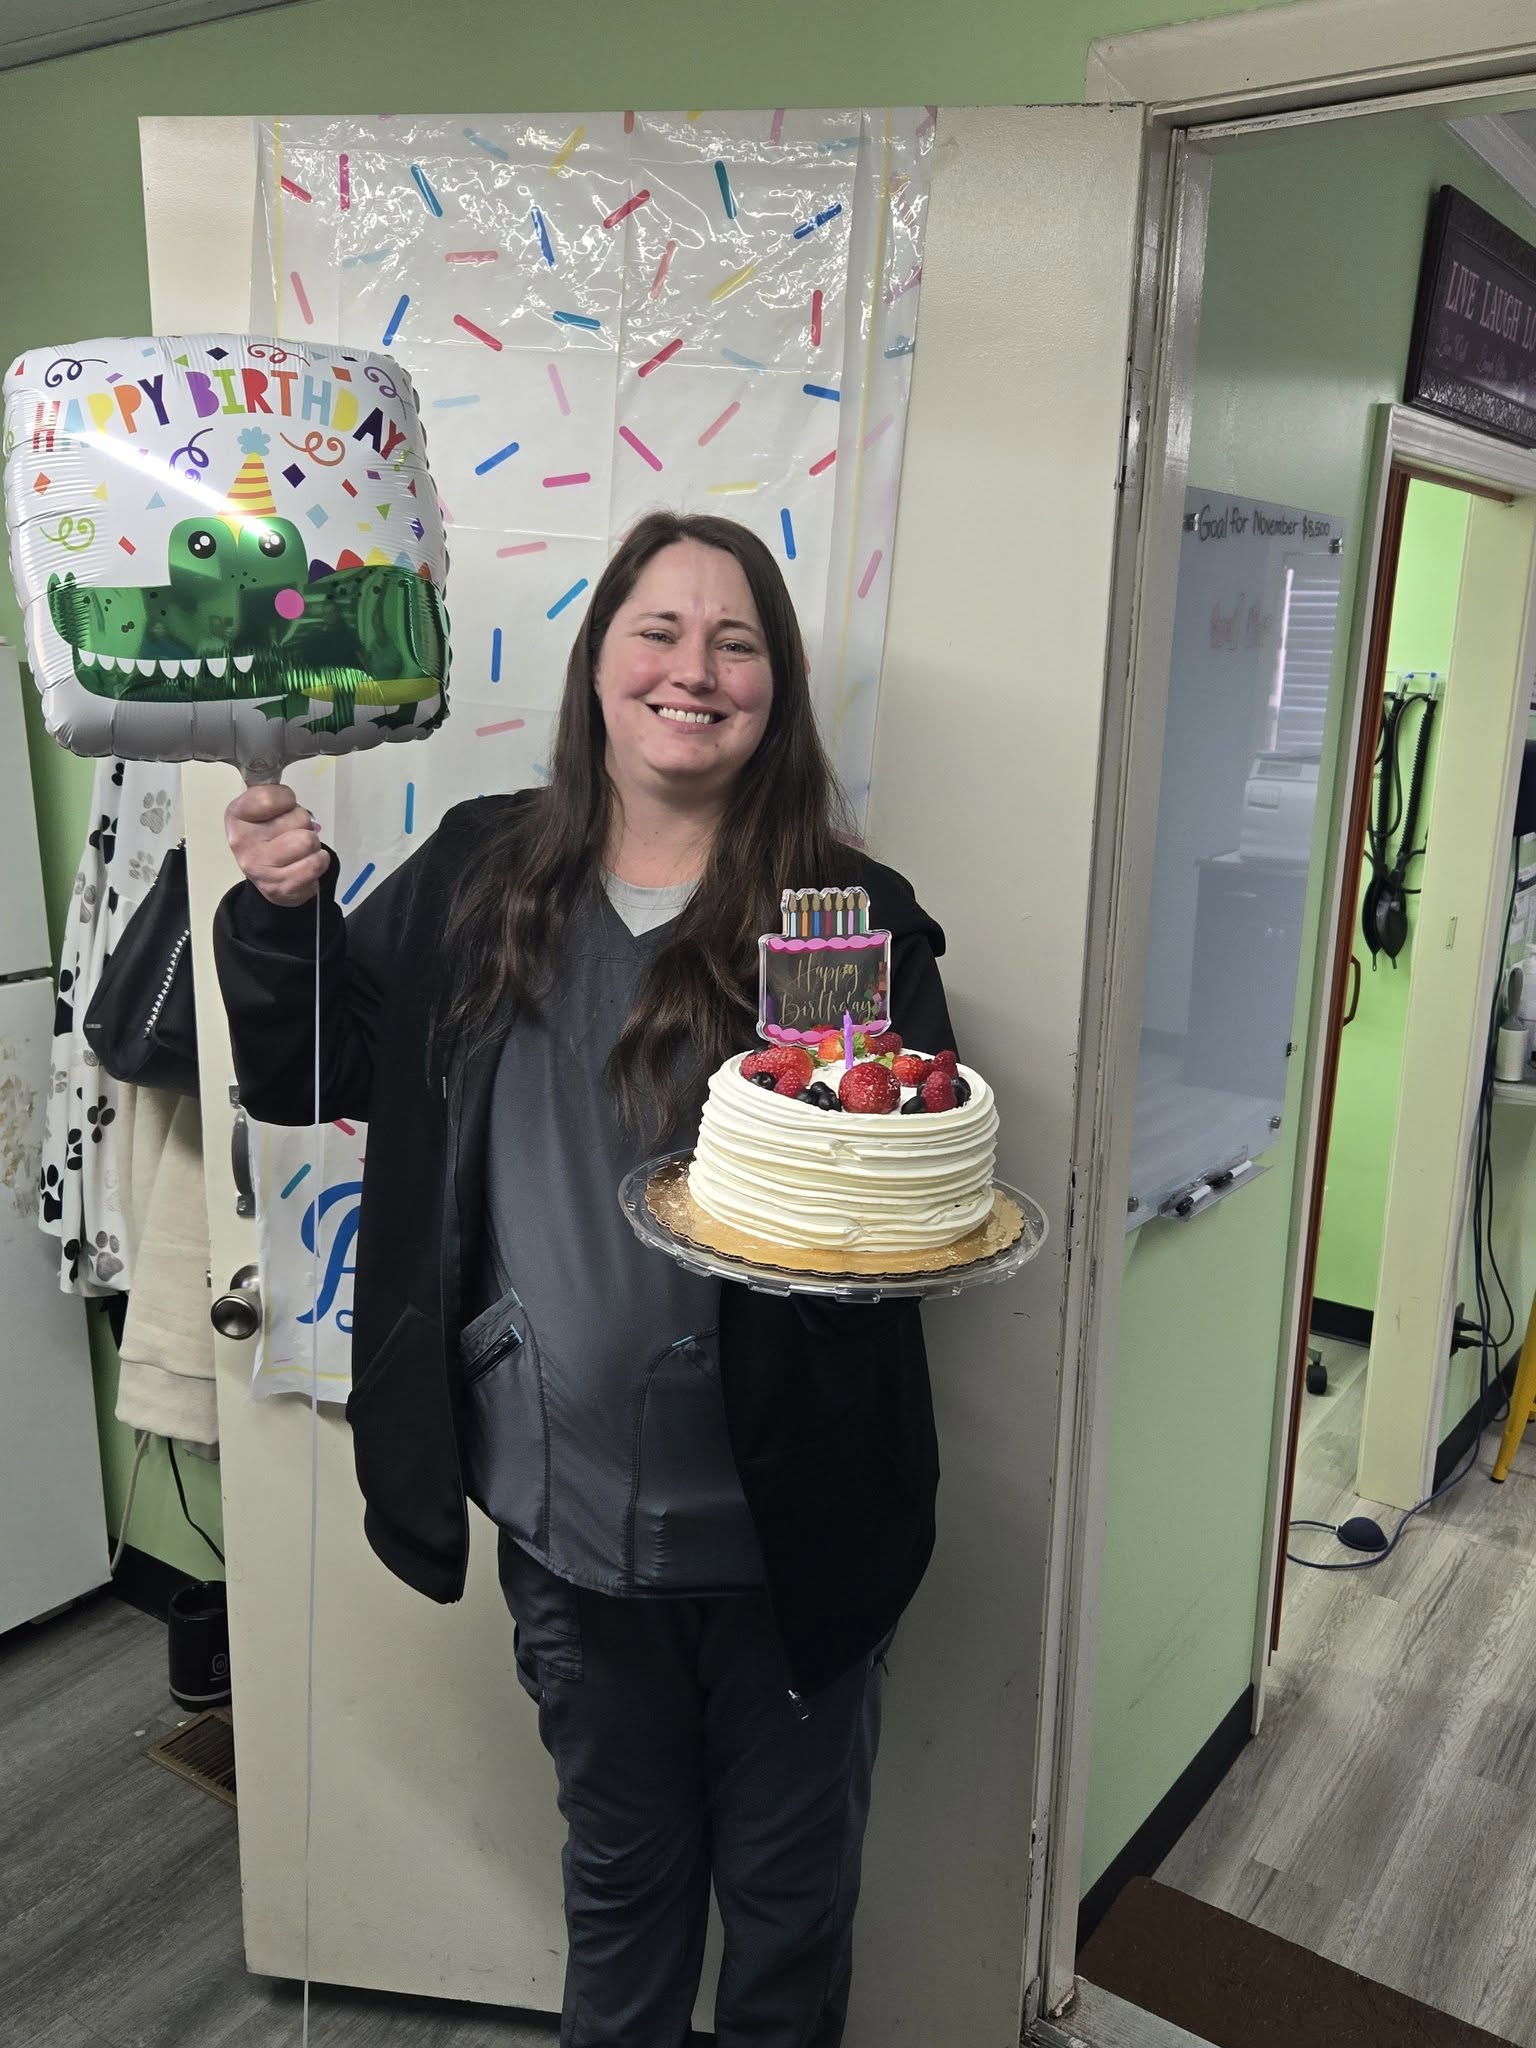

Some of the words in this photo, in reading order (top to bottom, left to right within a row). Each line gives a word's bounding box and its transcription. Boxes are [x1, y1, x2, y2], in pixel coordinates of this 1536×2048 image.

[1446, 260, 1479, 320] LIVE
[1480, 280, 1522, 343] LAUGH
[32, 374, 170, 454] HAPPY
[185, 368, 406, 460] BIRTHDAY
[1200, 504, 1229, 541] Goal
[1230, 507, 1249, 533] for
[1253, 510, 1299, 537] November
[790, 953, 864, 994] Happy
[779, 990, 876, 1026] Birthday
